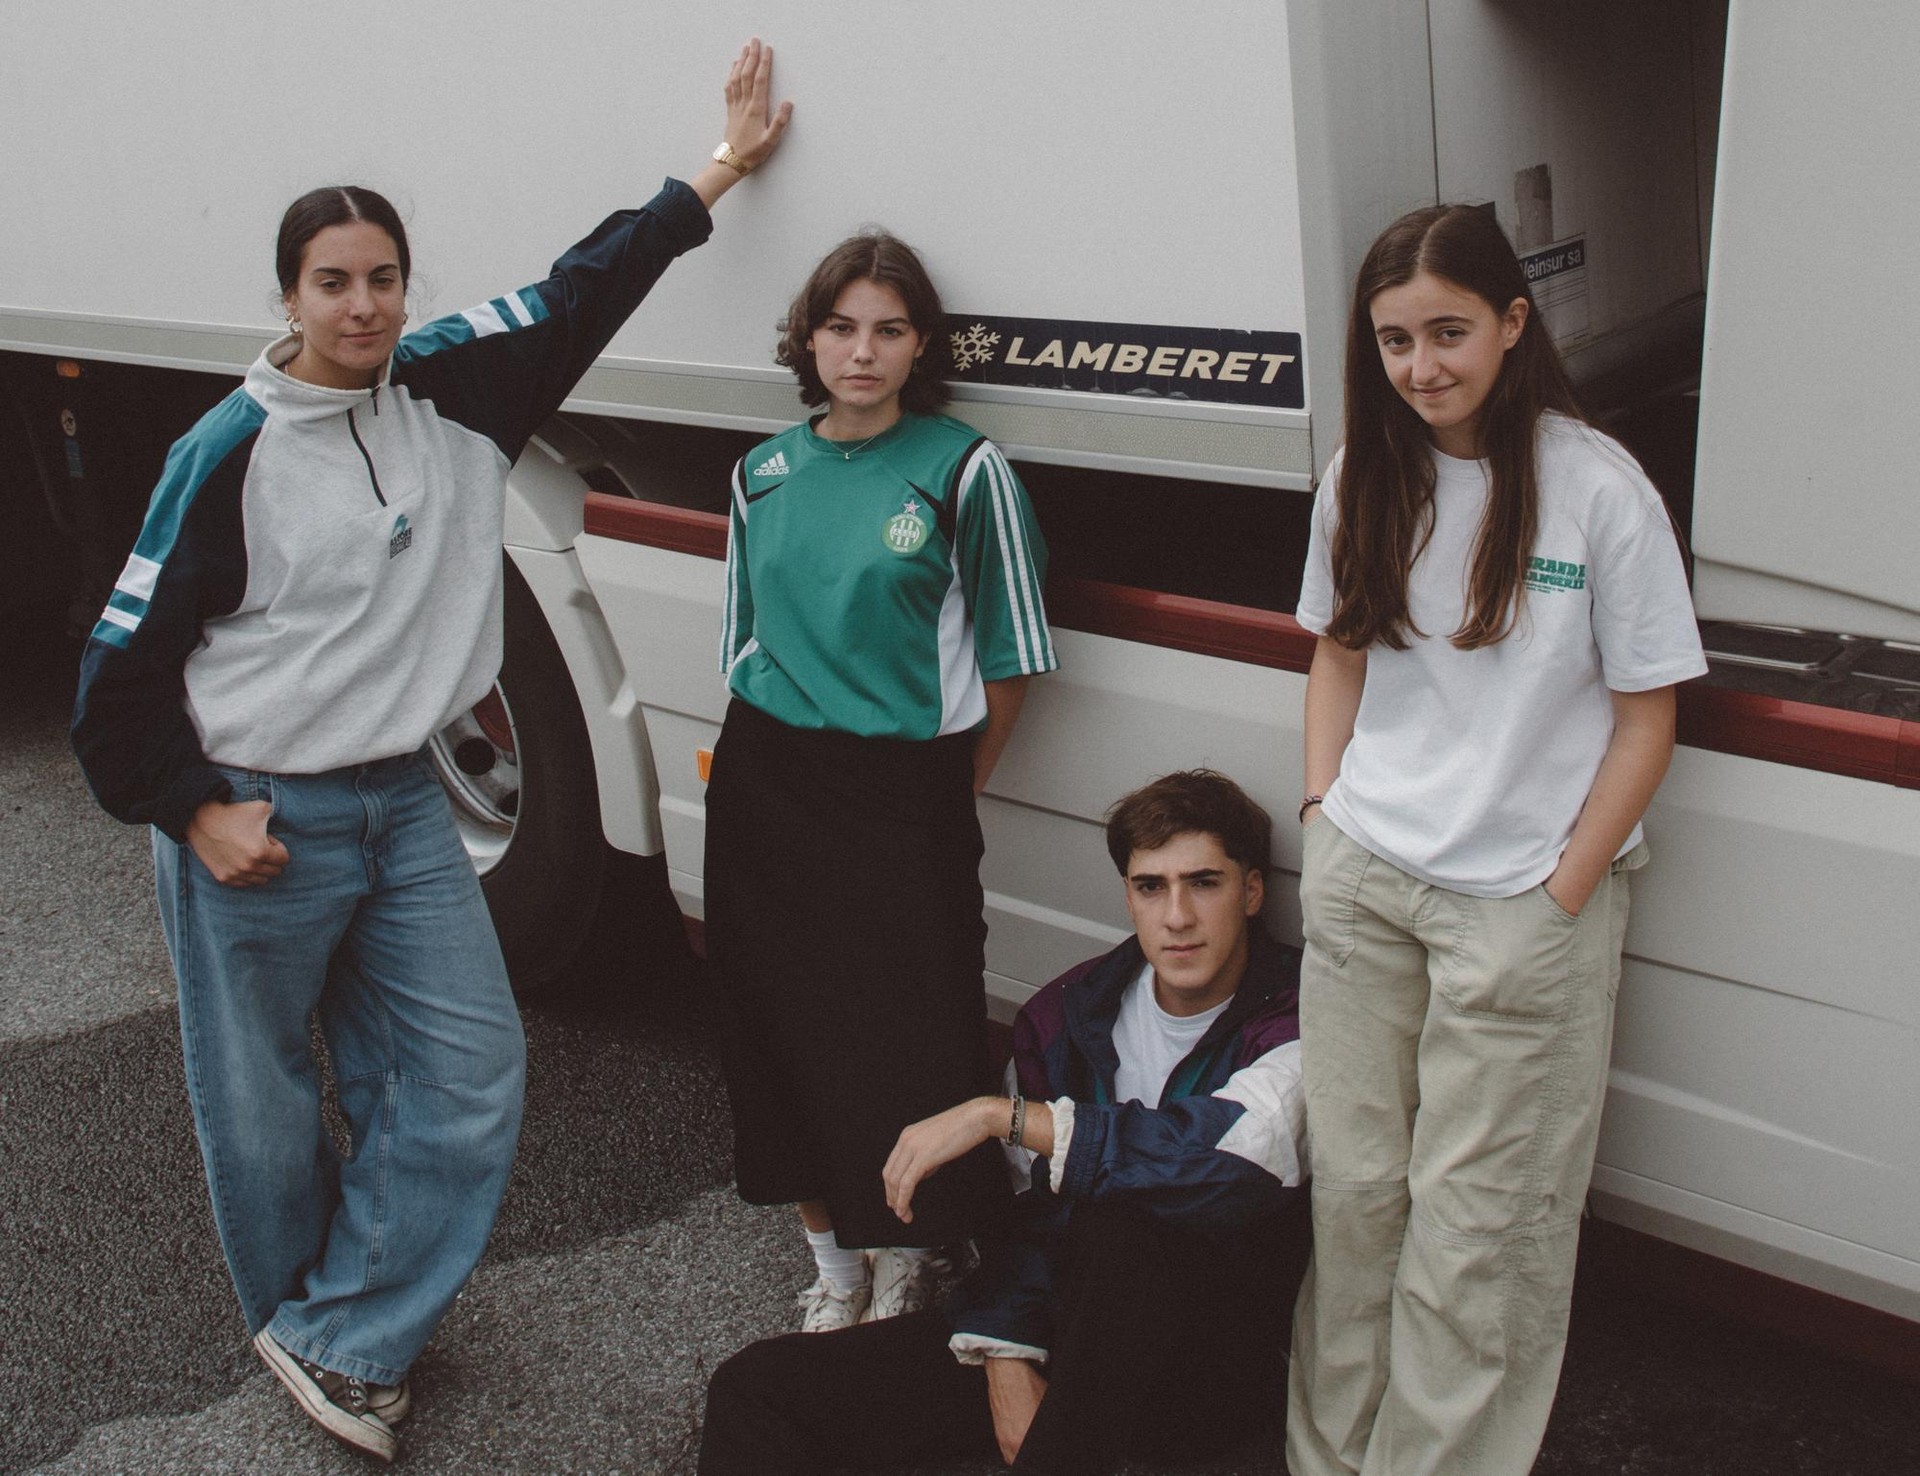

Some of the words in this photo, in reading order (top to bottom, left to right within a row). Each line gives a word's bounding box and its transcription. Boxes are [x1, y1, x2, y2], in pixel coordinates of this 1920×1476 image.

[1567, 248, 1581, 265] sa
[1004, 337, 1295, 384] LAMBERET
[753, 465, 789, 476] adidas
